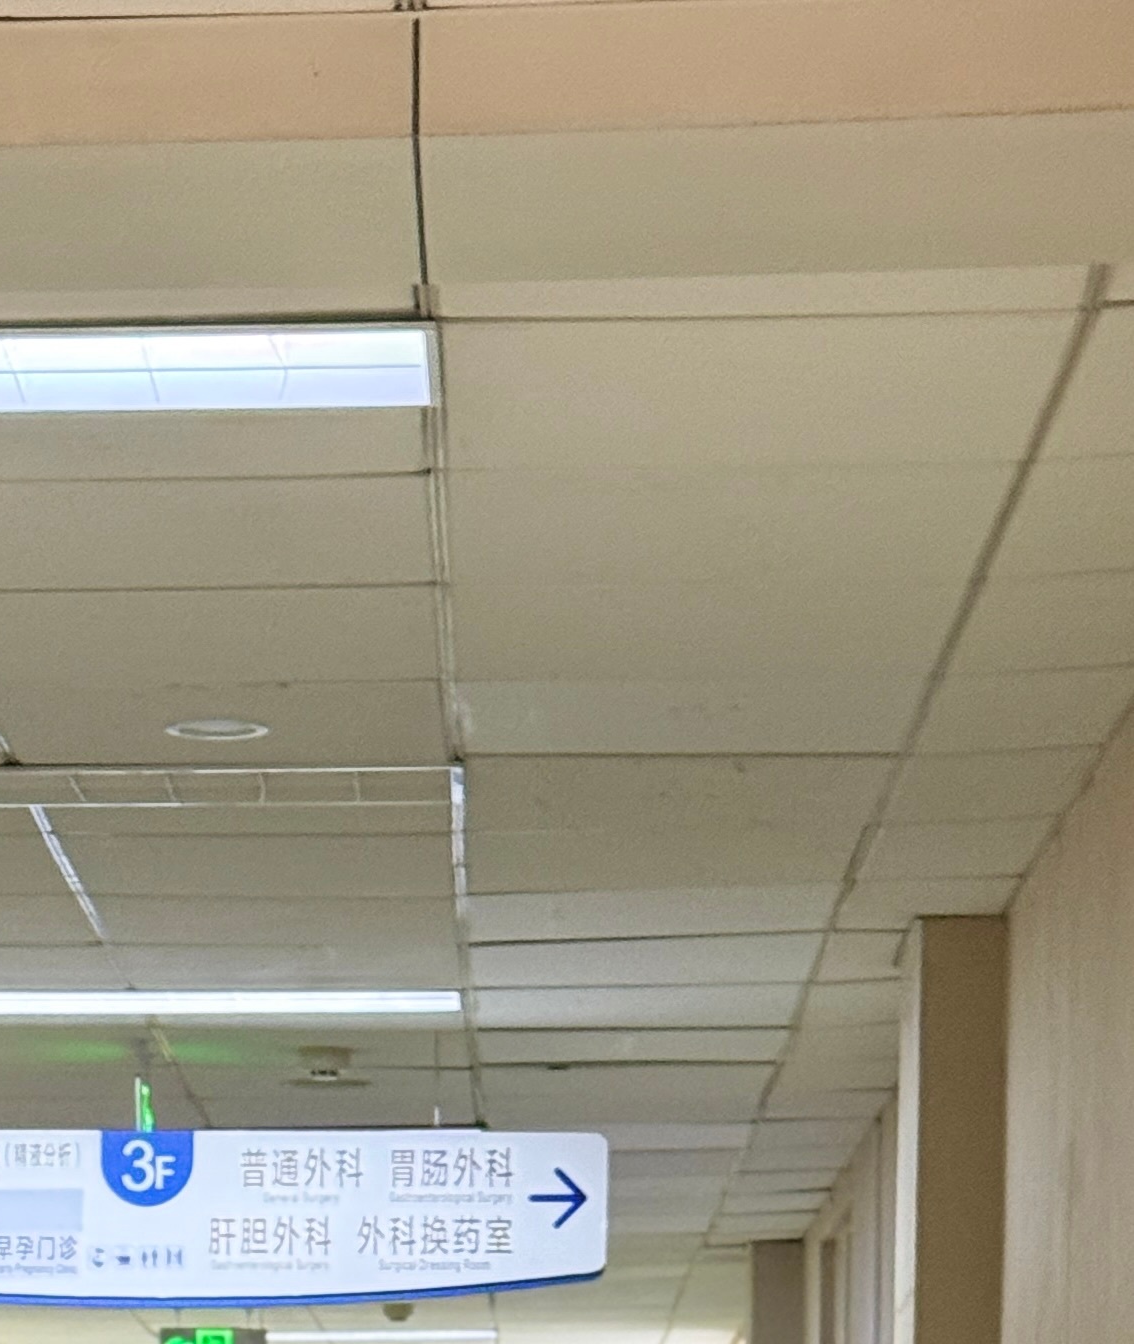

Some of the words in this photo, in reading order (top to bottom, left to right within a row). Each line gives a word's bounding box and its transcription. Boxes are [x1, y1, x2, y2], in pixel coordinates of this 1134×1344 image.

[121, 1139, 176, 1192] 3F
[240, 1147, 364, 1188] 普通外科
[390, 1147, 515, 1188] 胃肠外科
[208, 1214, 331, 1256] 肝胆外科
[357, 1214, 515, 1256] 外科换药室
